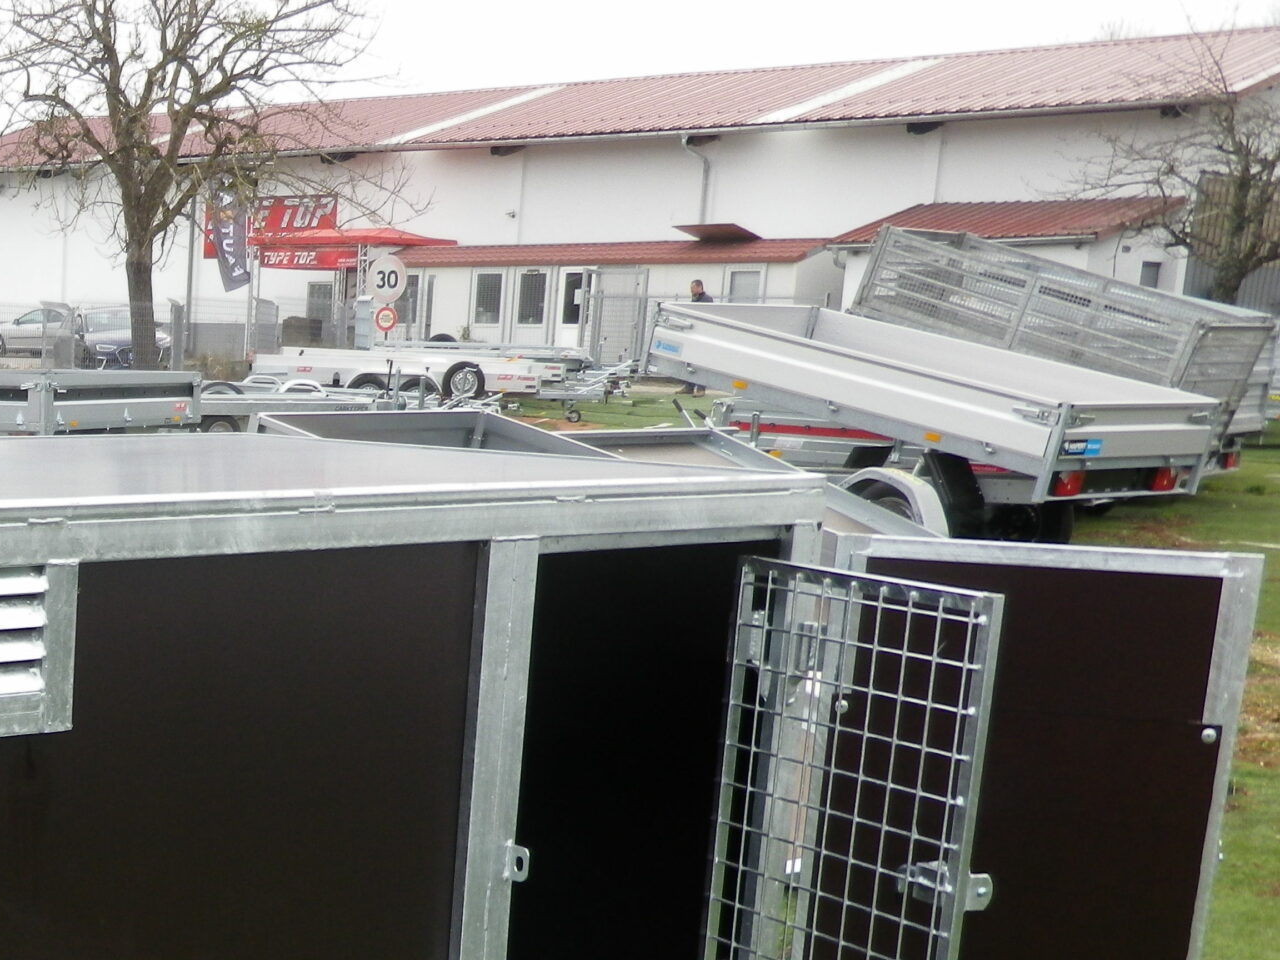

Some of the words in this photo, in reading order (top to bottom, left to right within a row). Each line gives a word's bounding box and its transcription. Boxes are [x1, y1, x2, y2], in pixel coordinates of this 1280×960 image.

[281, 197, 336, 229] TOP
[263, 252, 292, 265] TYPE
[294, 252, 317, 265] TOP
[376, 270, 399, 289] 30
